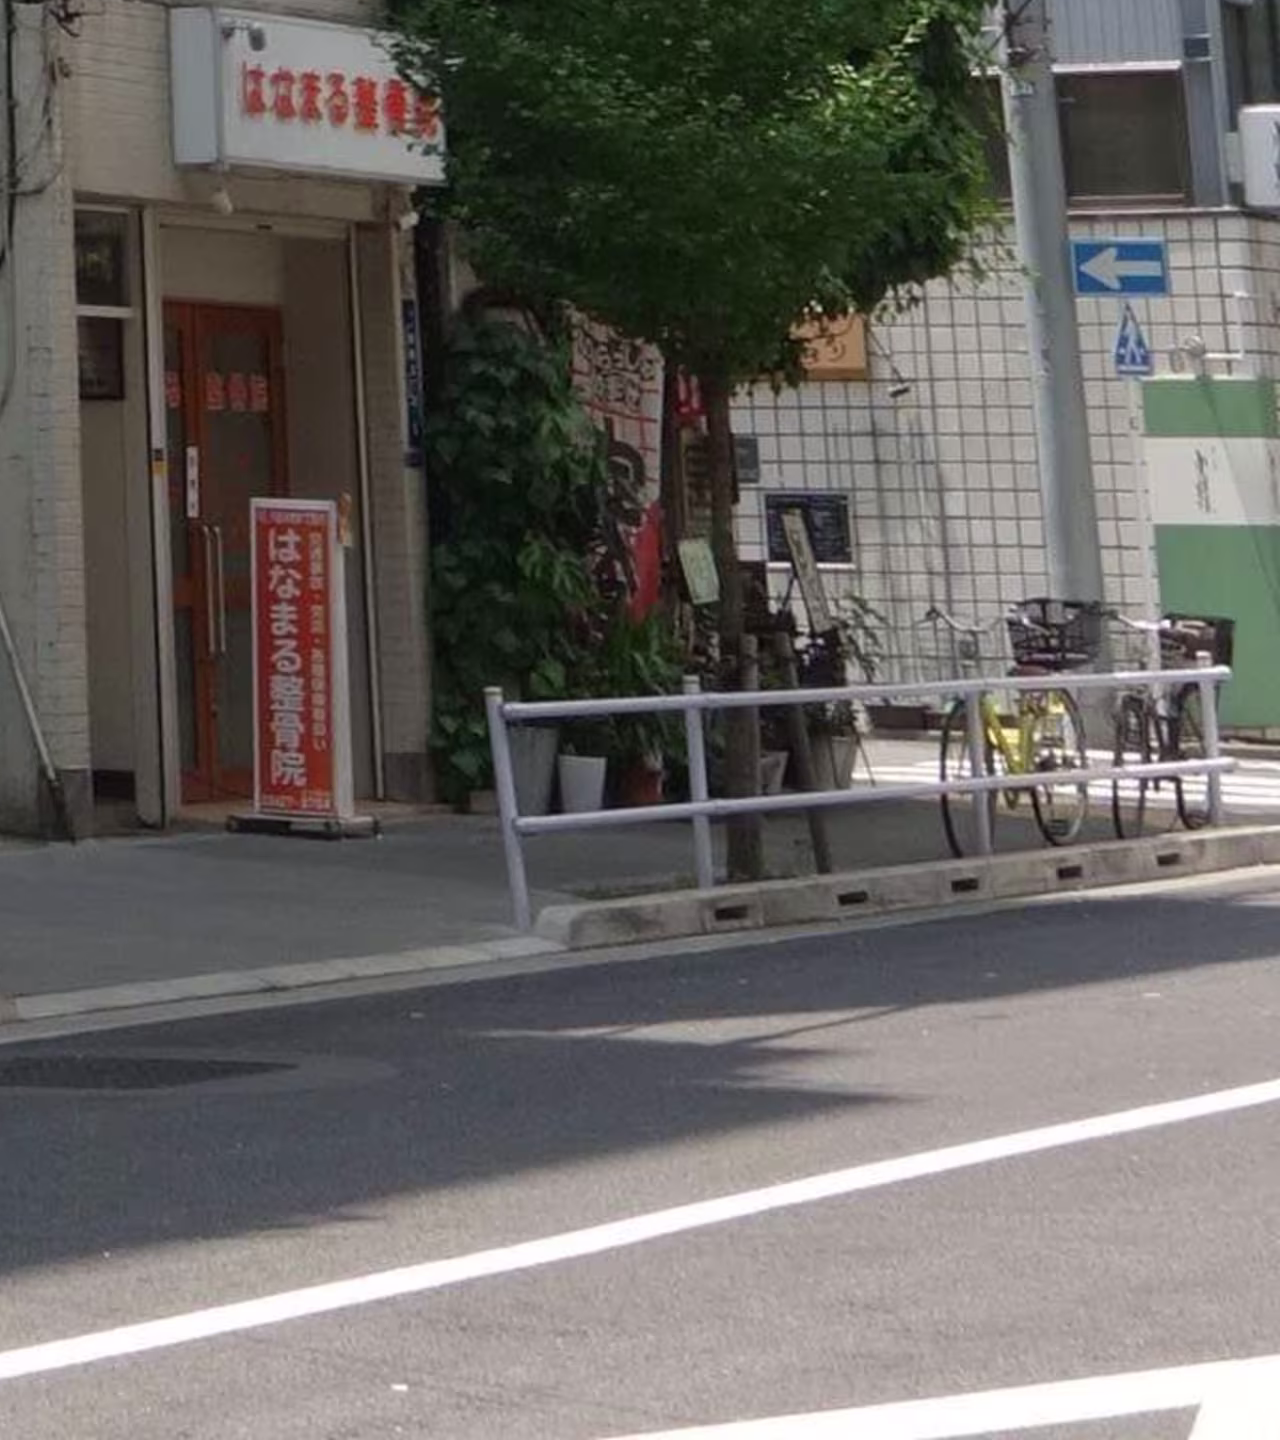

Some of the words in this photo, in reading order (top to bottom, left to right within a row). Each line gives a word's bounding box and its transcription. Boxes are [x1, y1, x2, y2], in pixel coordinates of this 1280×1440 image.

[268, 527, 308, 787] はなまる整骨院
